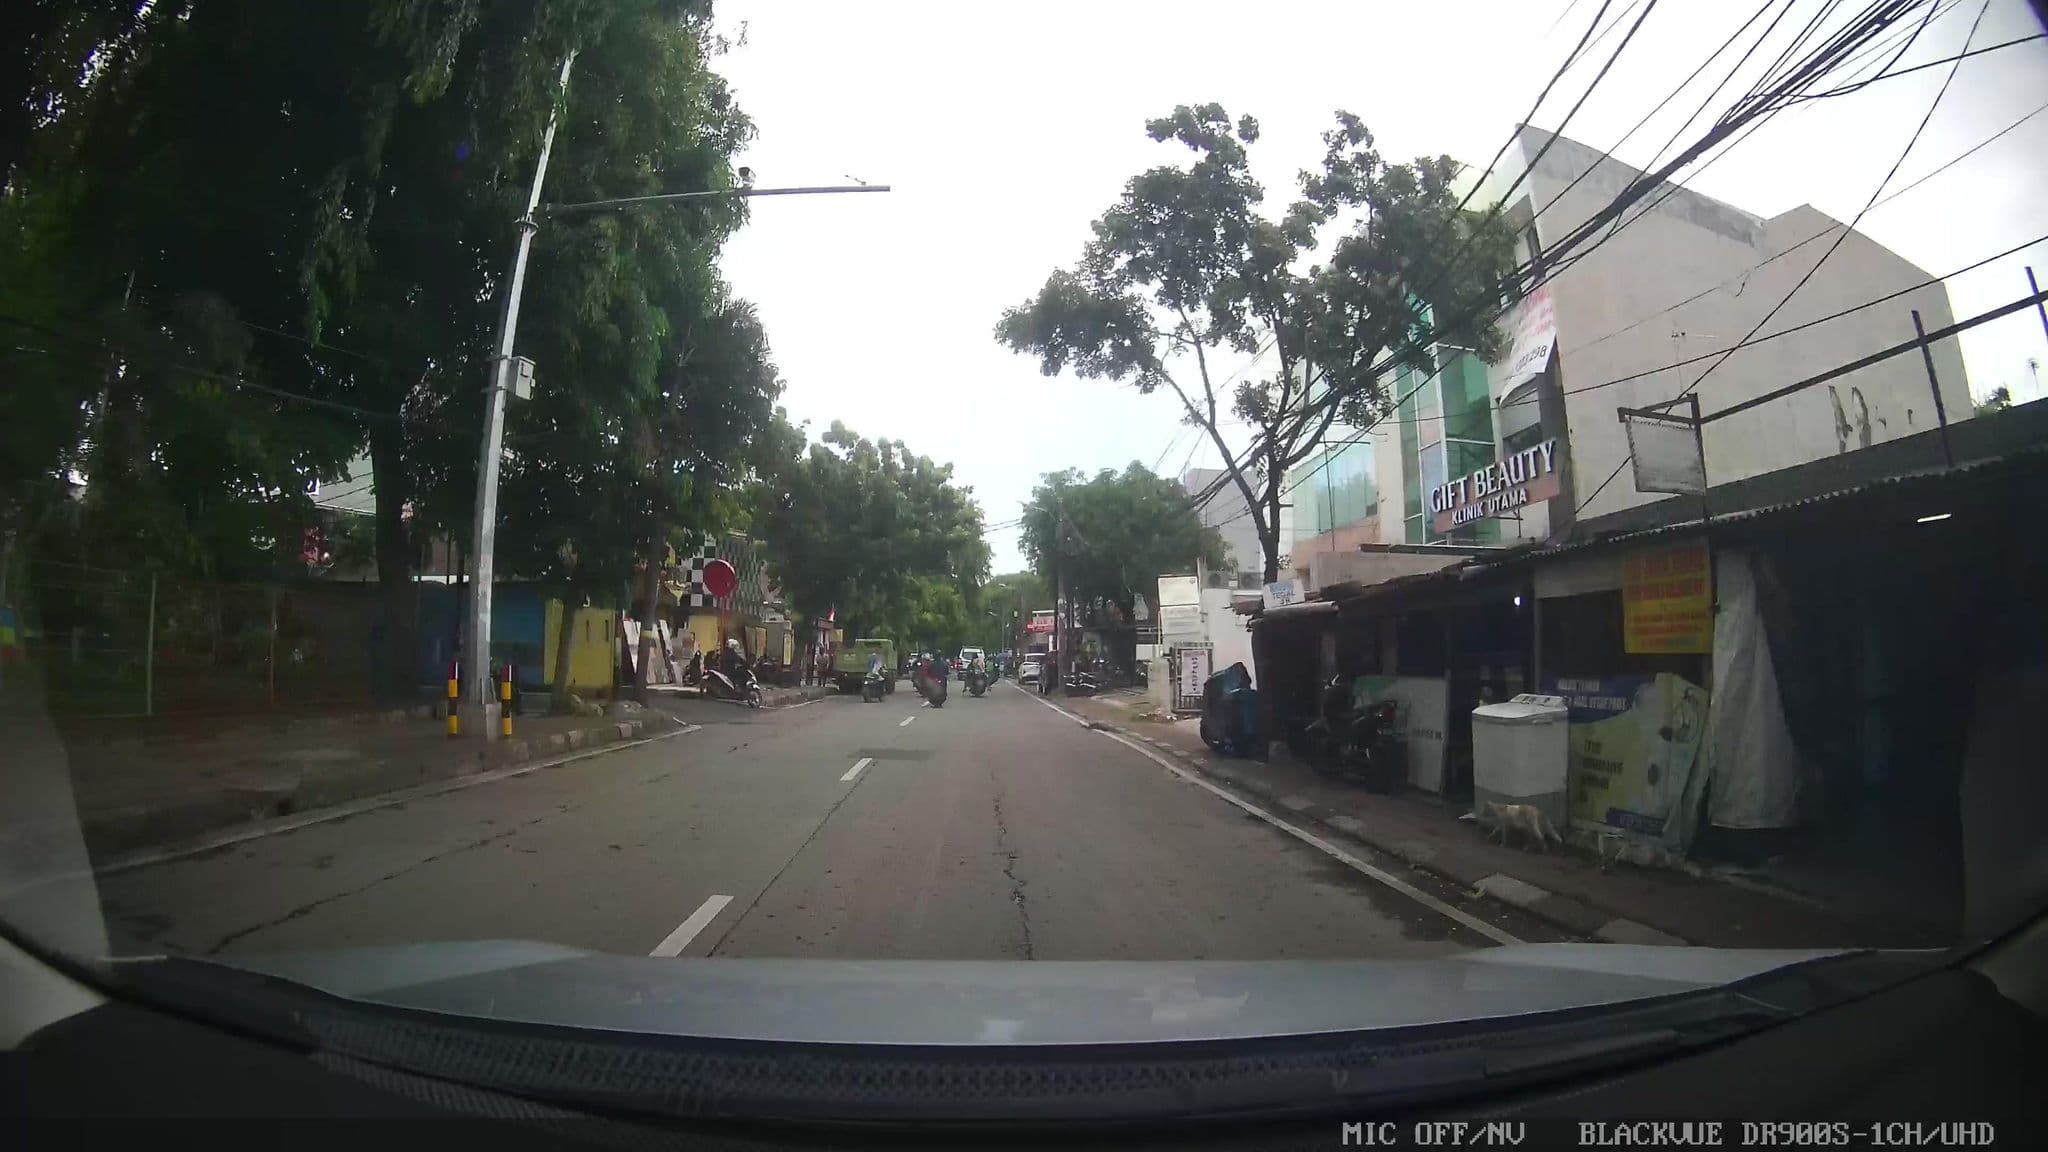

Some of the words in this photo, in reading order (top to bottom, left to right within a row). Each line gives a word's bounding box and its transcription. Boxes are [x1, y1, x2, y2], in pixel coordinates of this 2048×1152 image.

[1431, 476, 1468, 512] GIFT
[1473, 439, 1555, 498] BEAUTY
[1451, 501, 1484, 525] KLINIK
[1488, 487, 1527, 512] UTAMA
